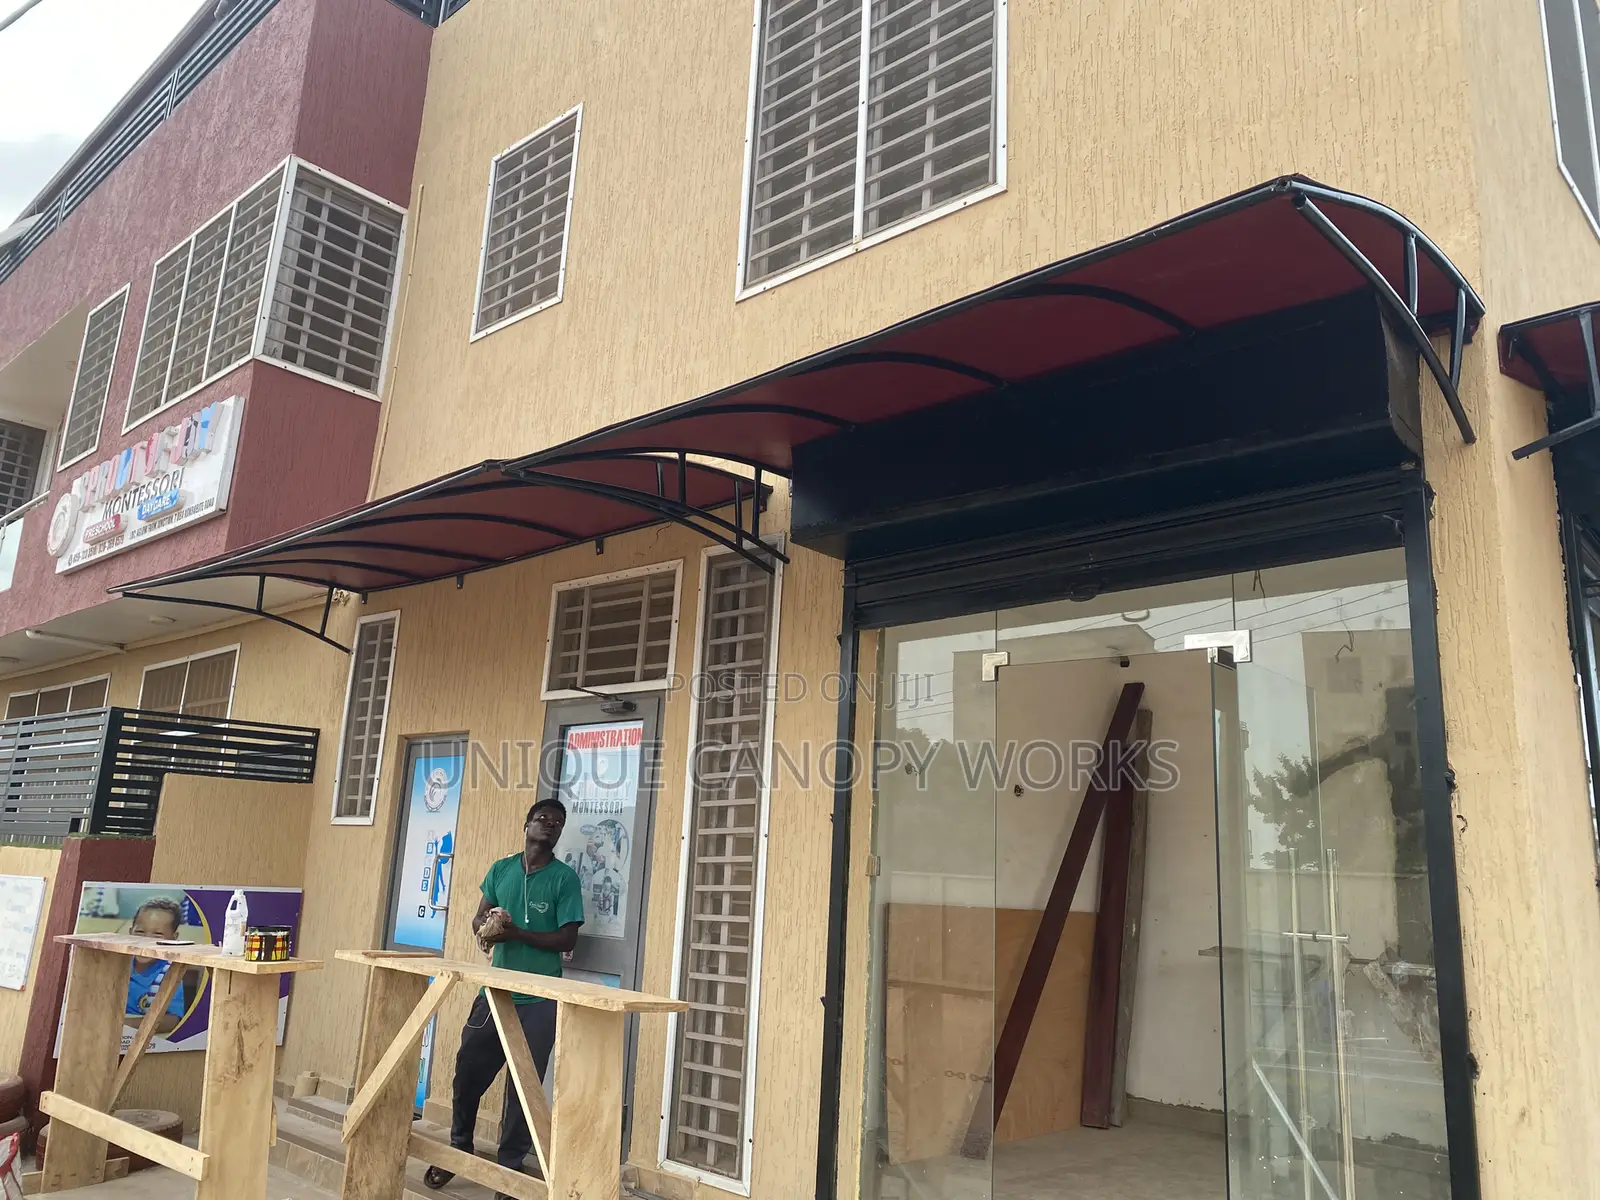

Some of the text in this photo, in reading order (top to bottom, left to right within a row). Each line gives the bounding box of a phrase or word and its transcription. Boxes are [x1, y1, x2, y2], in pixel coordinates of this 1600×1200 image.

[102, 467, 185, 521] MONTESSORI
[568, 727, 643, 750] ADMINISTRATION
[571, 800, 623, 814] MONTESSORI
